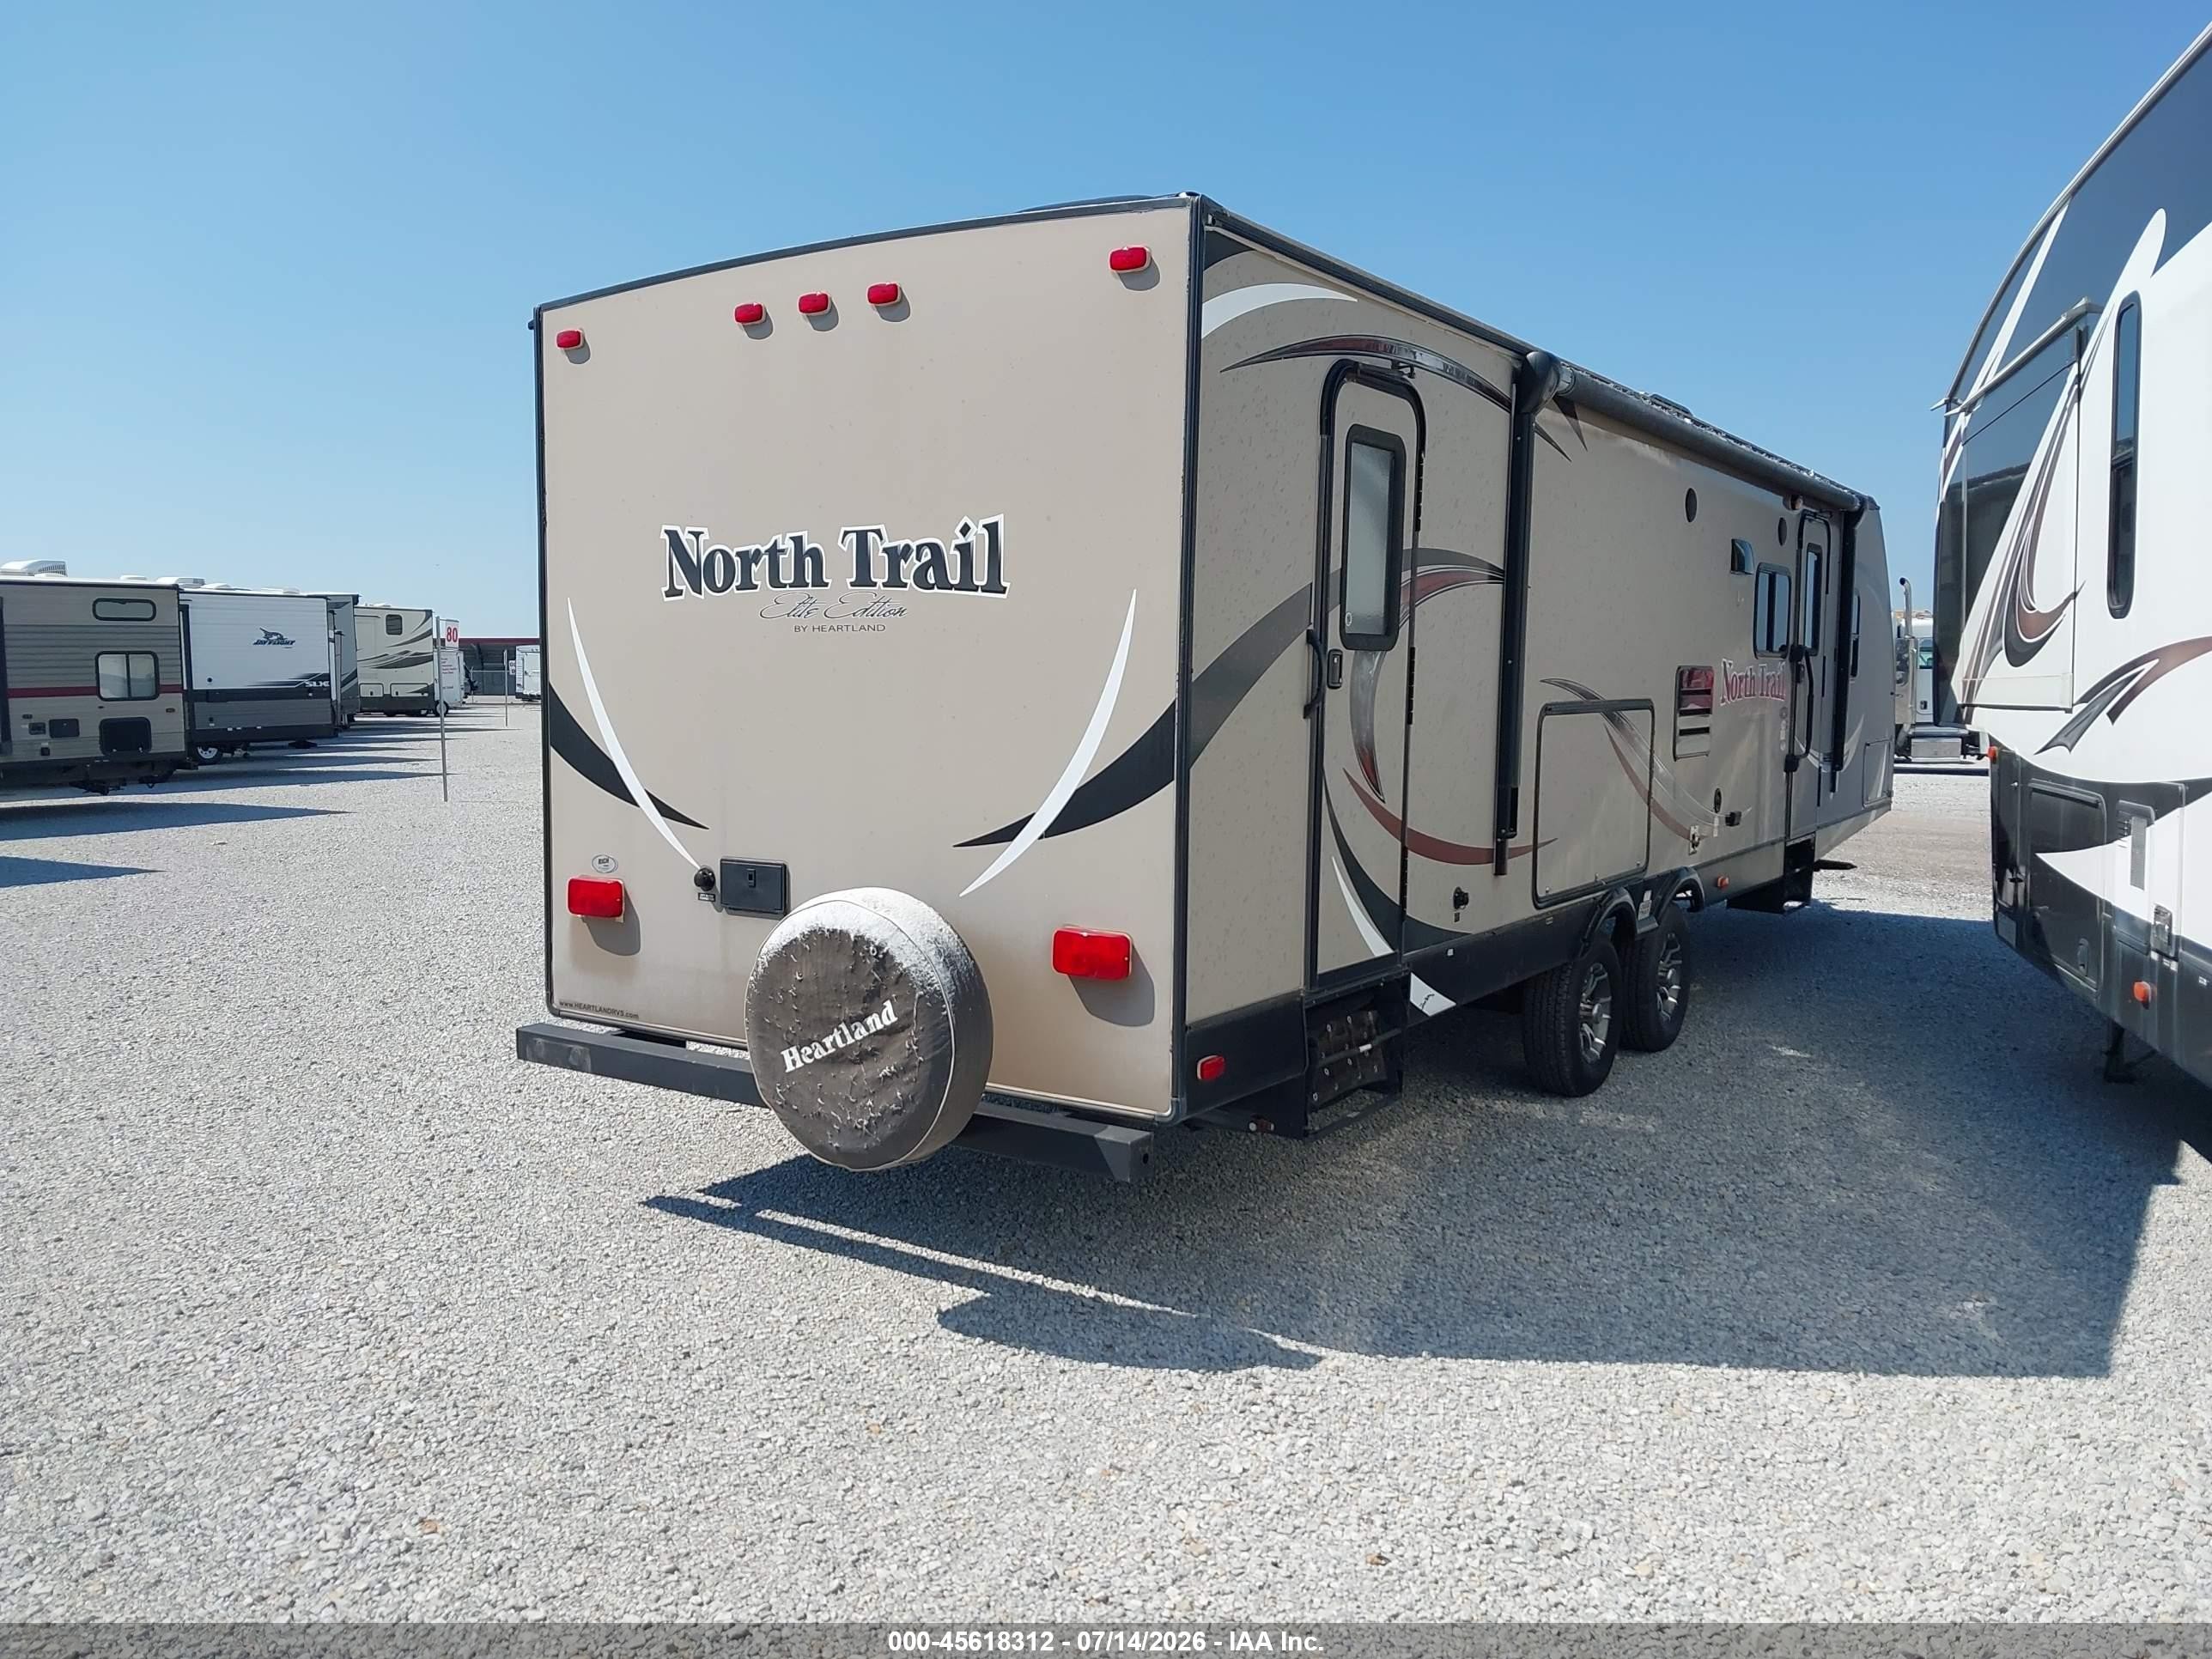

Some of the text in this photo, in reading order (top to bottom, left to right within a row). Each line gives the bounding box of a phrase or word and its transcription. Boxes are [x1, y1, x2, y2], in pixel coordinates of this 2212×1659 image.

[661, 514, 1010, 600] North Trail
[760, 592, 908, 619] Elite Edition
[447, 626, 459, 642] 80
[793, 623, 886, 633] BY HEARTLAND
[1720, 659, 1786, 706] North Trail
[780, 1000, 899, 1073] Heartland
